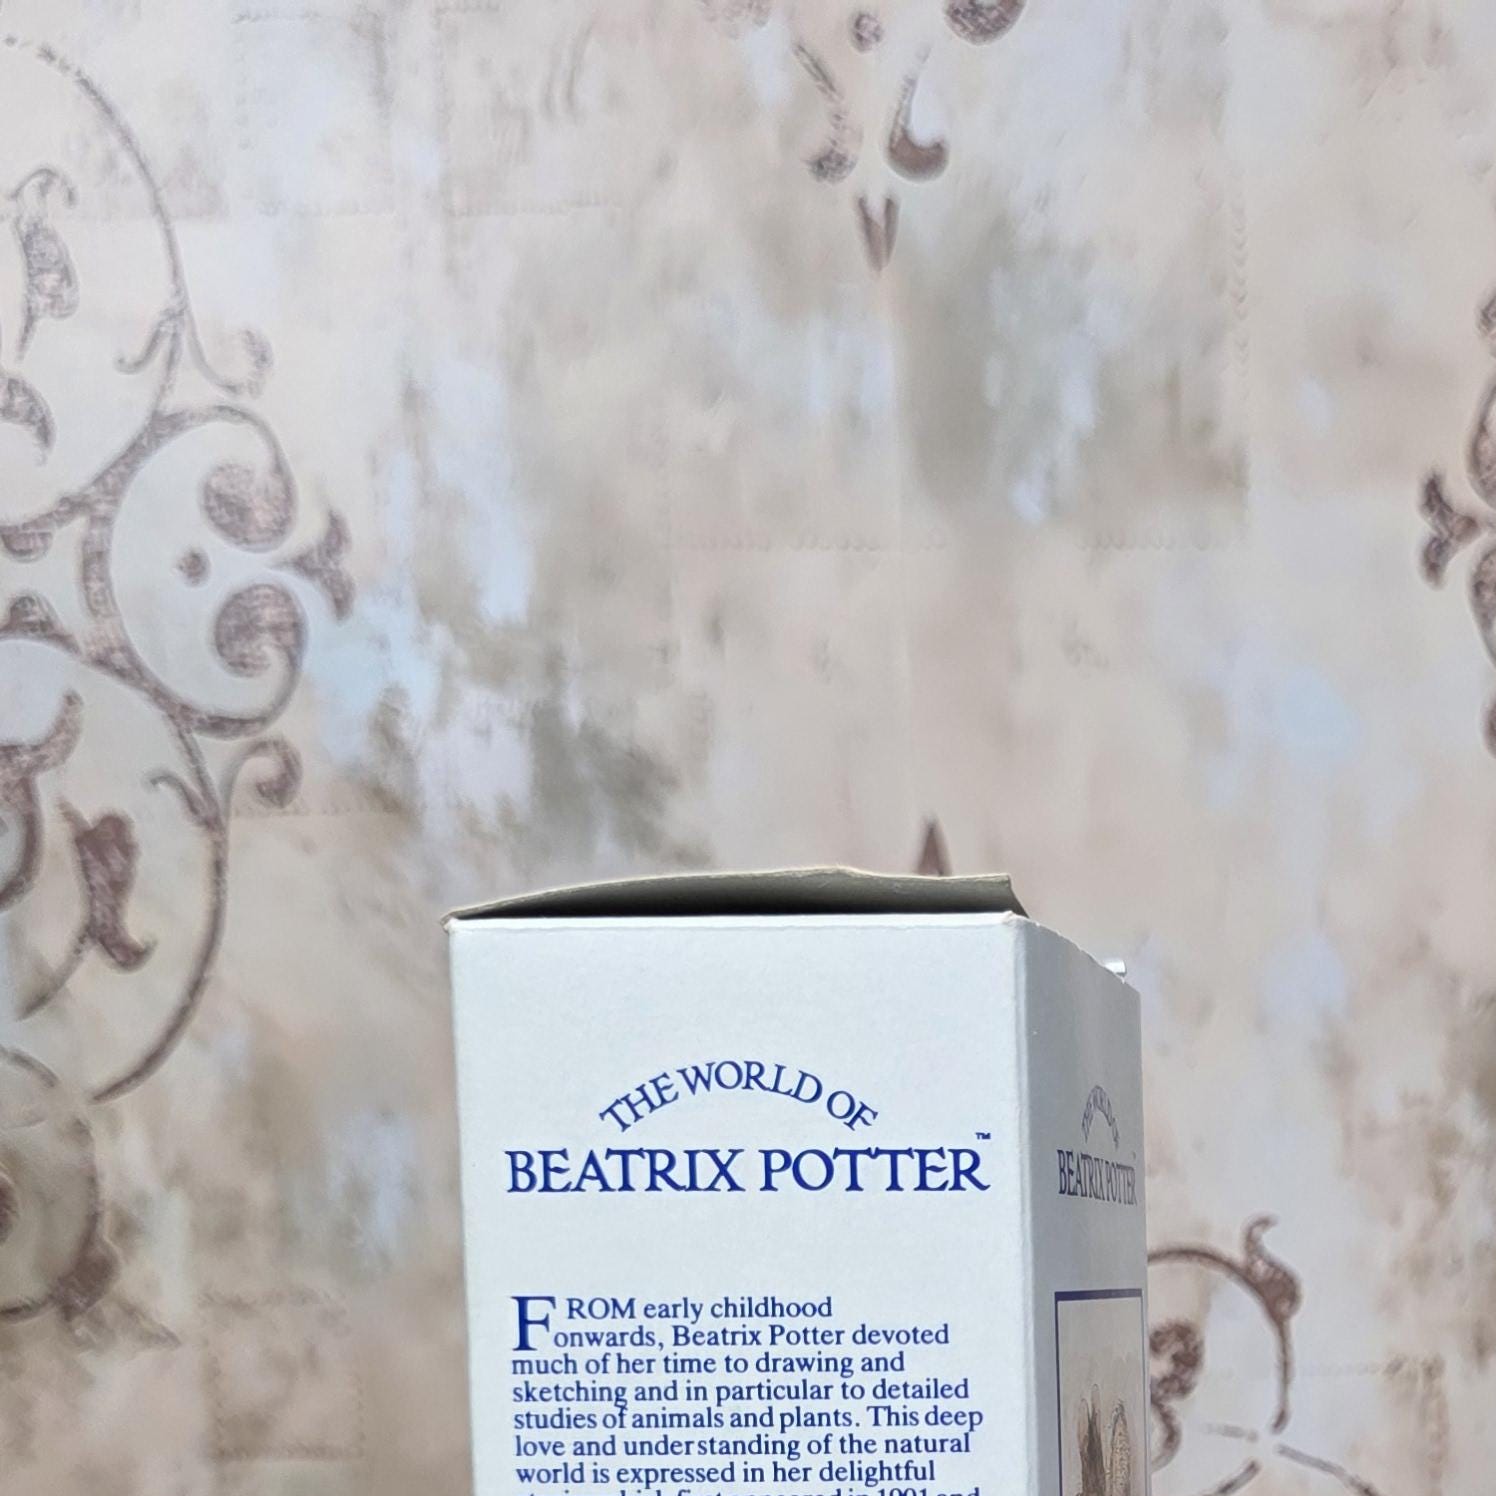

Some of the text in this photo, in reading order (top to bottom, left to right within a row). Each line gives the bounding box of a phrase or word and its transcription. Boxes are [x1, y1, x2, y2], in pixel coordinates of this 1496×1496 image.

[597, 1060, 879, 1133] THE WORLD OF
[503, 1146, 747, 1194] BEATRIX
[642, 1296, 704, 1326] early
[710, 1295, 833, 1319] childhood
[552, 1322, 950, 1352] onwards, Beatrix Potter devoted
[511, 1349, 906, 1380] much of her time to drawing and
[512, 1377, 970, 1408] sketching and in particular to detailed
[513, 1404, 985, 1435] studies of animals and plants. This deep
[514, 1431, 971, 1462] love and understanding of the natural
[514, 1459, 936, 1490] world is expressed in her delightful
